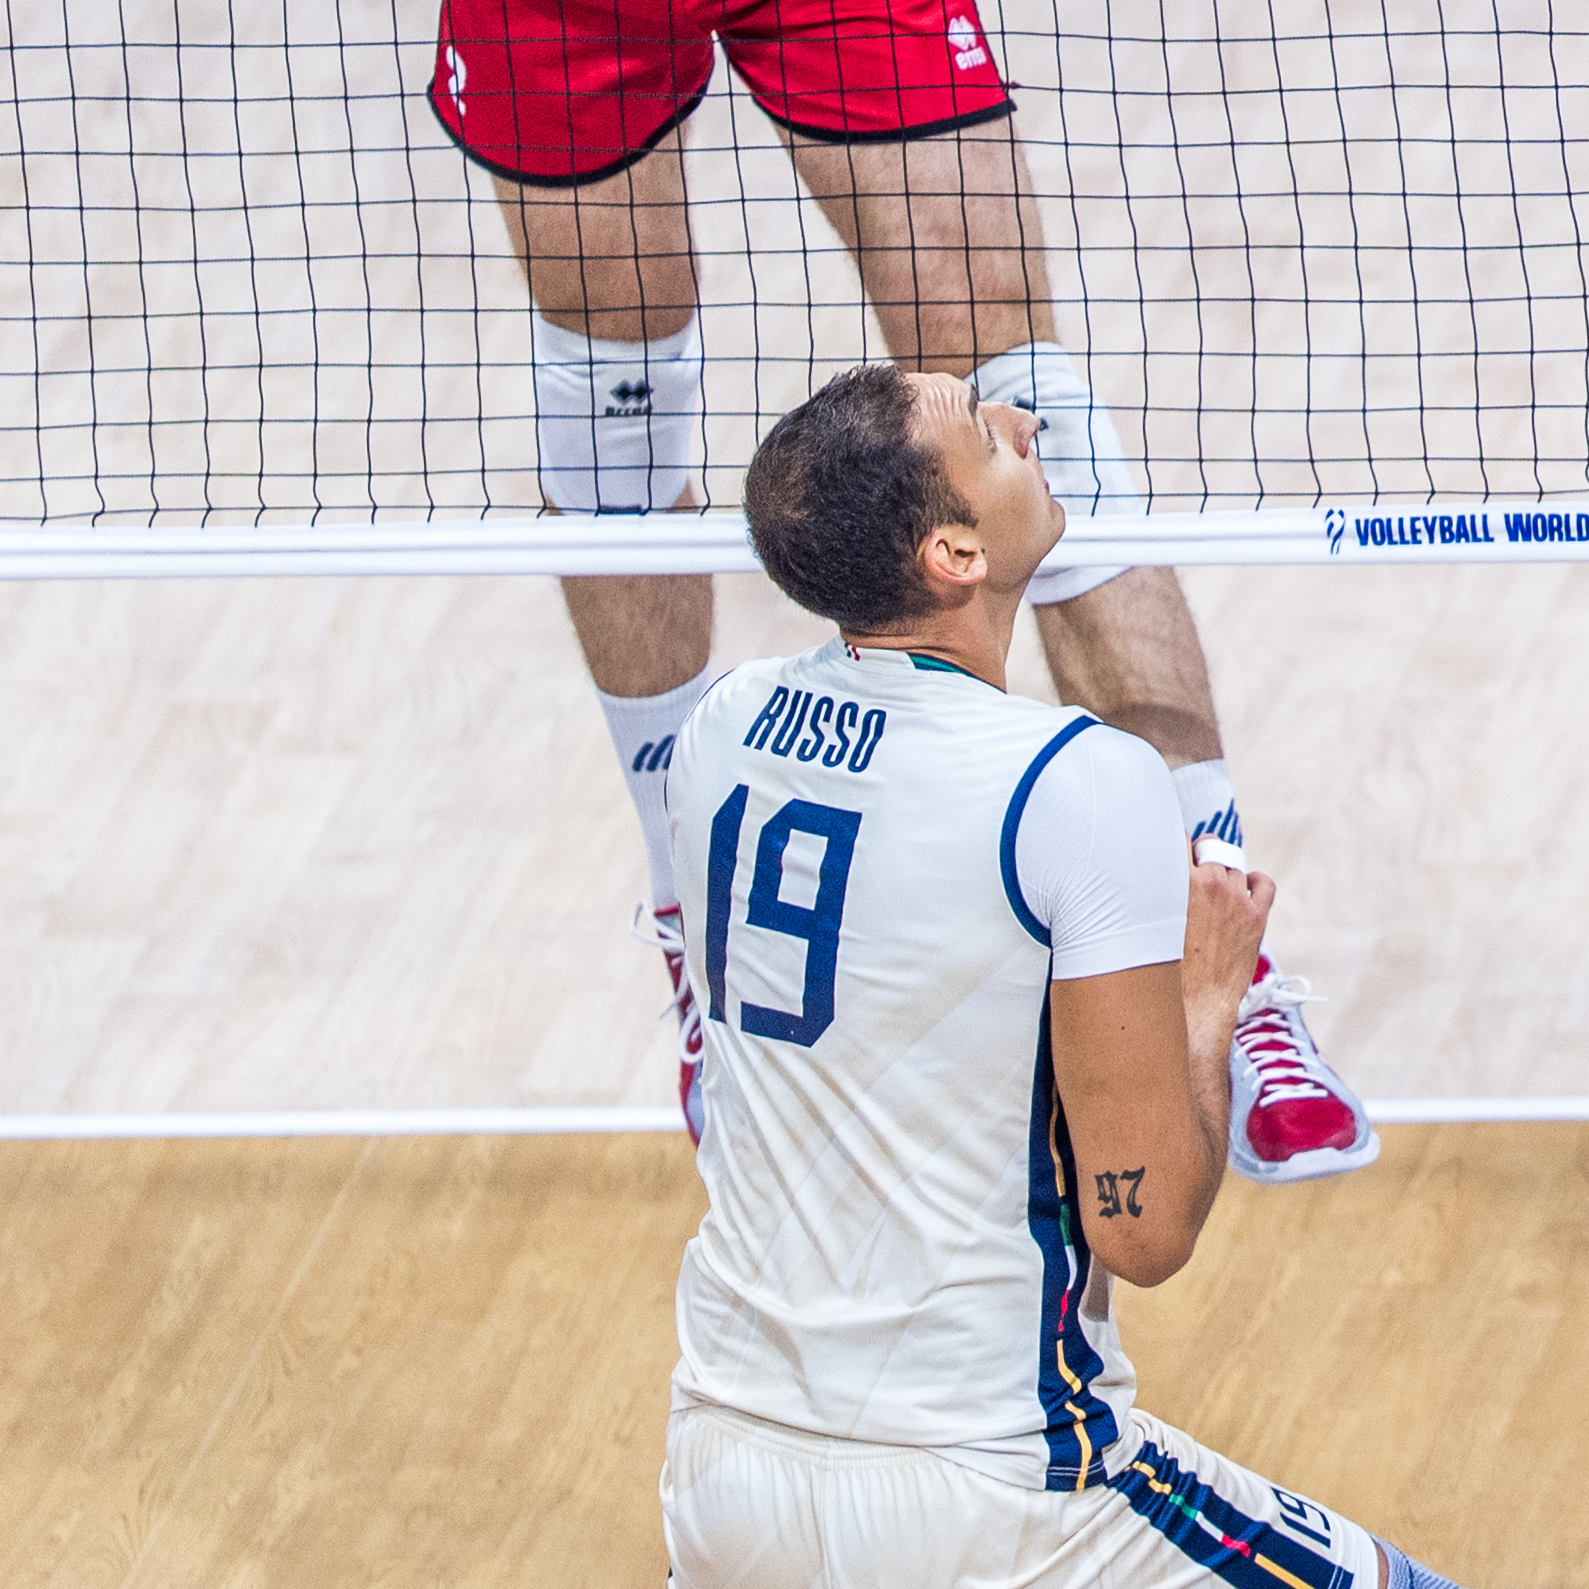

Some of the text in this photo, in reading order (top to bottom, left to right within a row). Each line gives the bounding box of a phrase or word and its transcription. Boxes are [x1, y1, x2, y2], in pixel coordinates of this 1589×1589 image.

[1355, 514, 1495, 547] VOLLEYBALL
[742, 685, 887, 773] RUSSO
[705, 783, 863, 1049] 19
[1094, 1164, 1146, 1220] 97
[1269, 1486, 1332, 1550] 19
